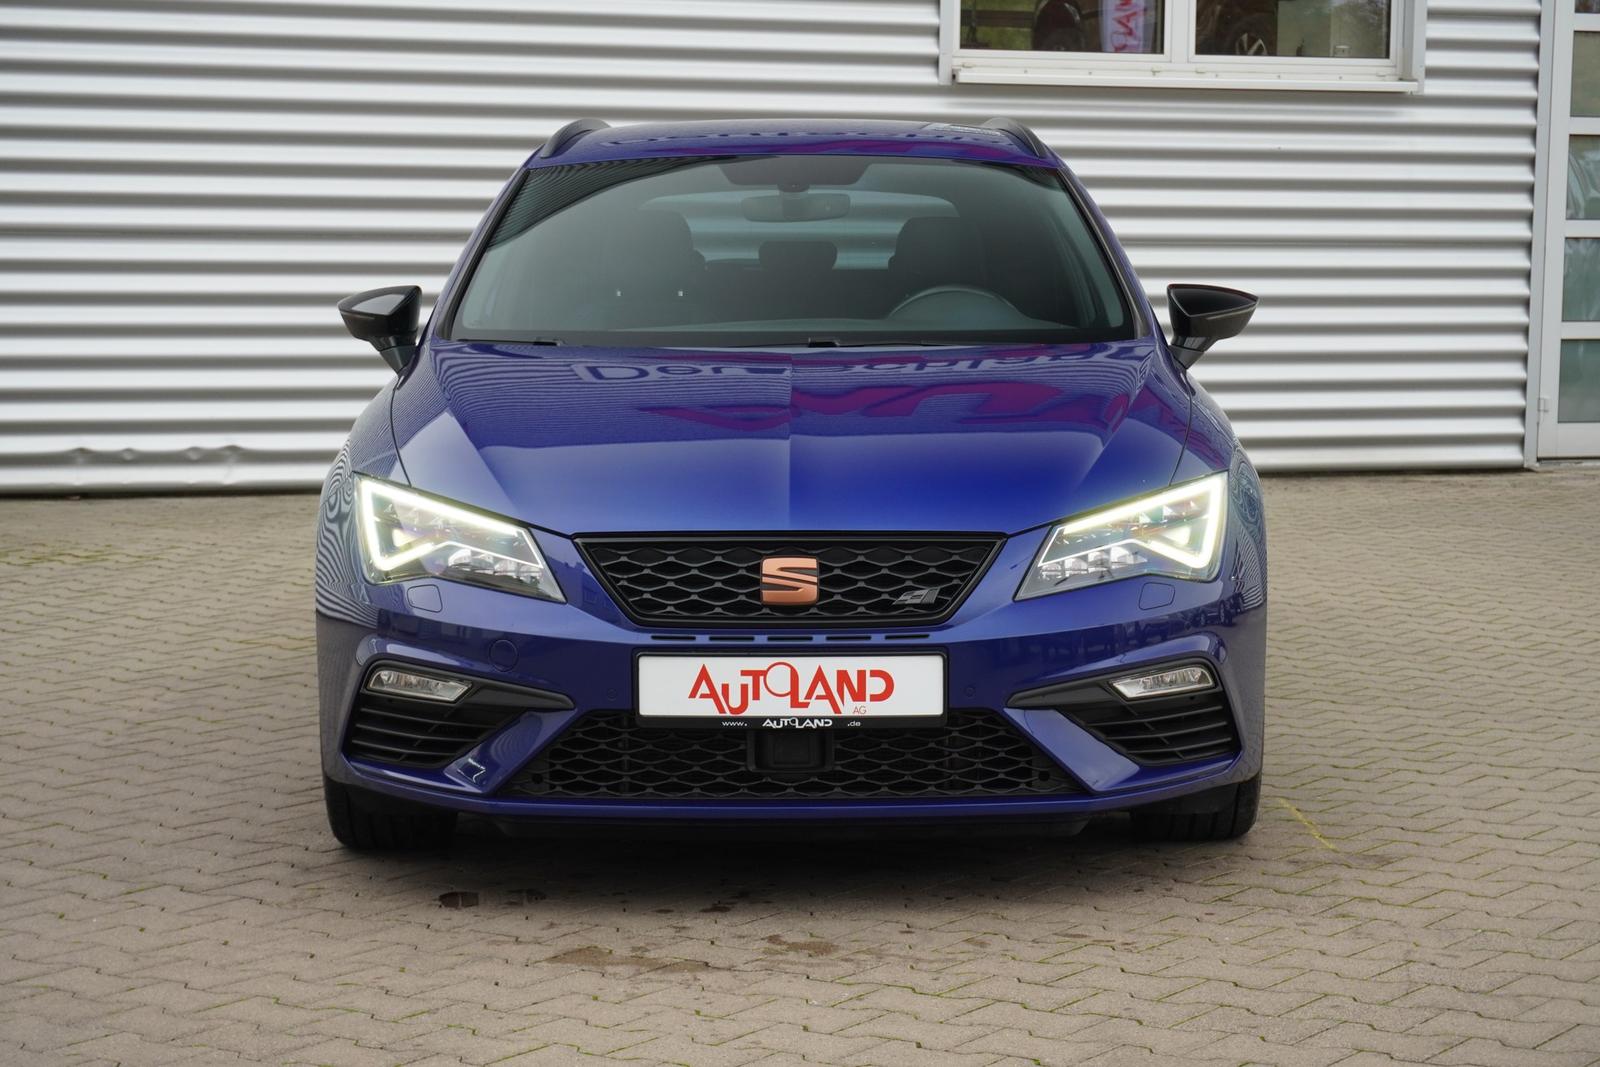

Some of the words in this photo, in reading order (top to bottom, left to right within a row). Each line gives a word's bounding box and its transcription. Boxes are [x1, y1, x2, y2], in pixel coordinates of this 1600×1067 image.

[688, 661, 895, 716] AUTOLAND
[852, 705, 868, 715] AG
[762, 717, 833, 729] AUTOLAND
